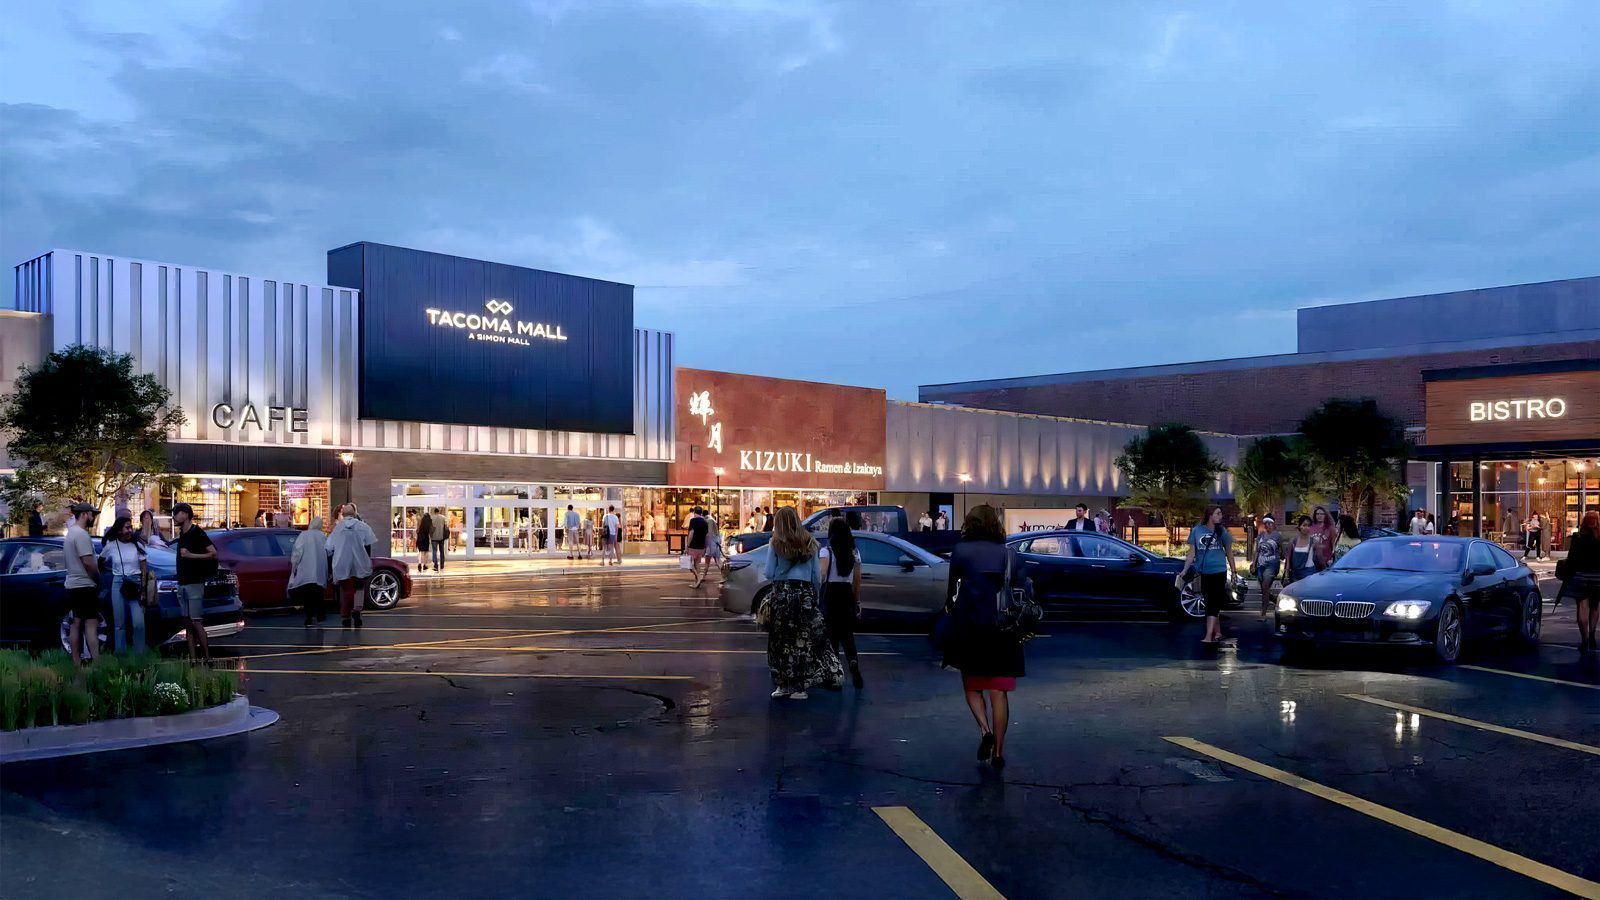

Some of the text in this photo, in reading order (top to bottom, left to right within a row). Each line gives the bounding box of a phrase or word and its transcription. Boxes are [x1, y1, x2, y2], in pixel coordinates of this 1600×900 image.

[425, 308, 568, 341] TACOMA MALL
[477, 334, 506, 343] SIMON
[507, 337, 530, 346] MALL
[211, 403, 309, 433] CAFE
[1470, 398, 1566, 421] BISTRO
[739, 450, 883, 478] KIZUKI Ramen & Izakaya
